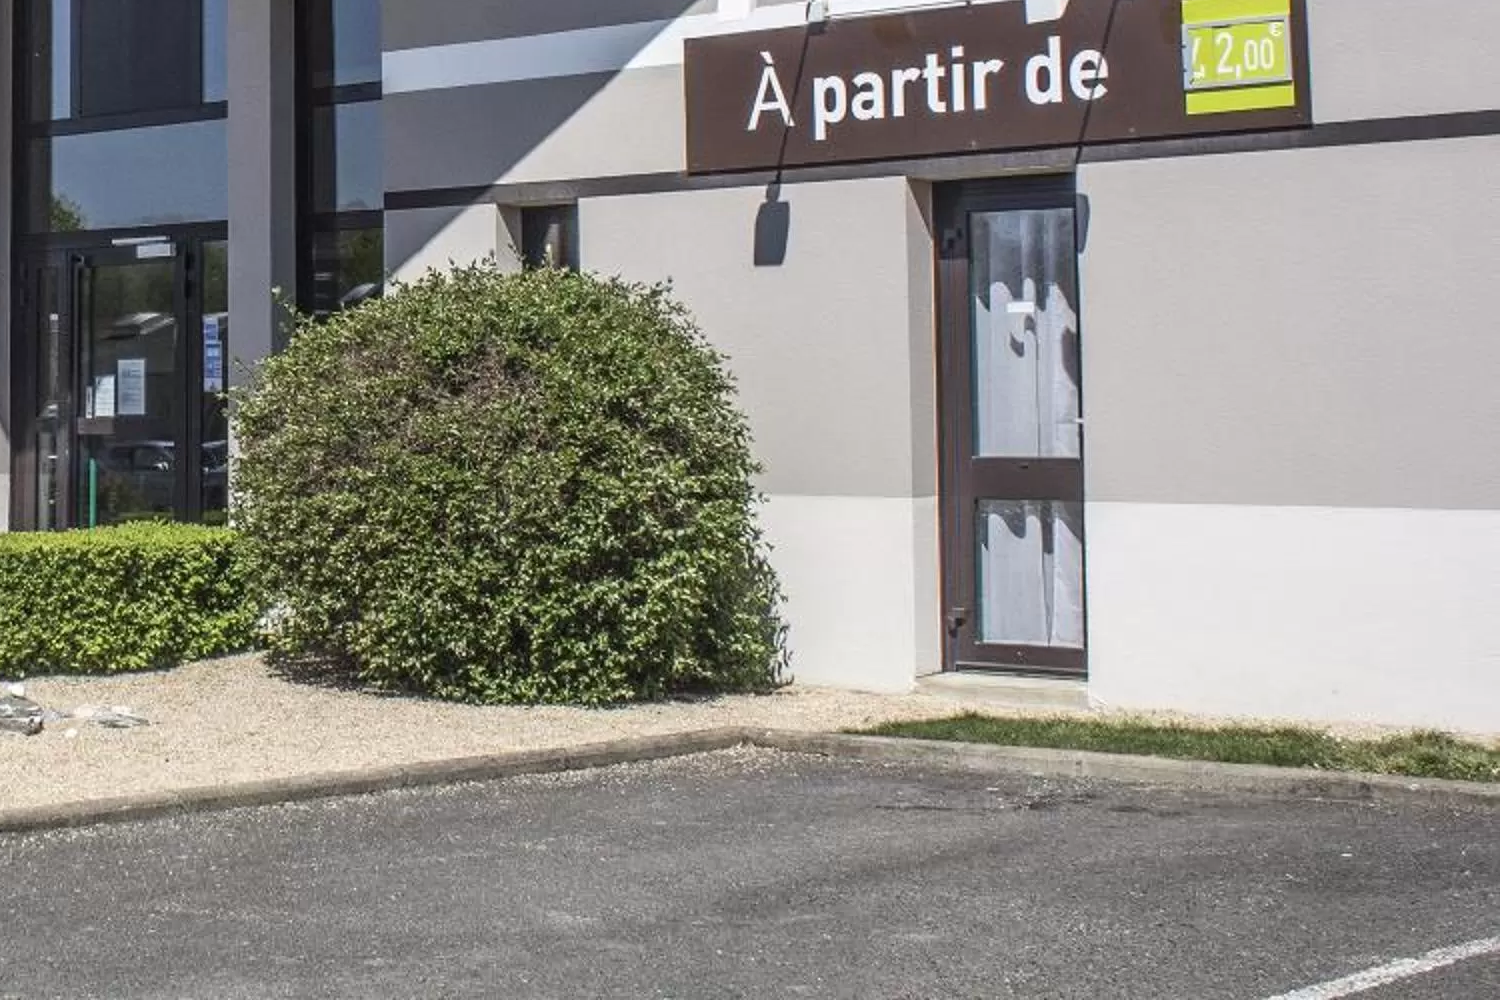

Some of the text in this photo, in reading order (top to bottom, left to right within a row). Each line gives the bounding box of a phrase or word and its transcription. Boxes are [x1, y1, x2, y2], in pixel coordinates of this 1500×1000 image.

[748, 52, 796, 131] À
[813, 46, 1005, 140] partir
[1027, 36, 1109, 105] de
